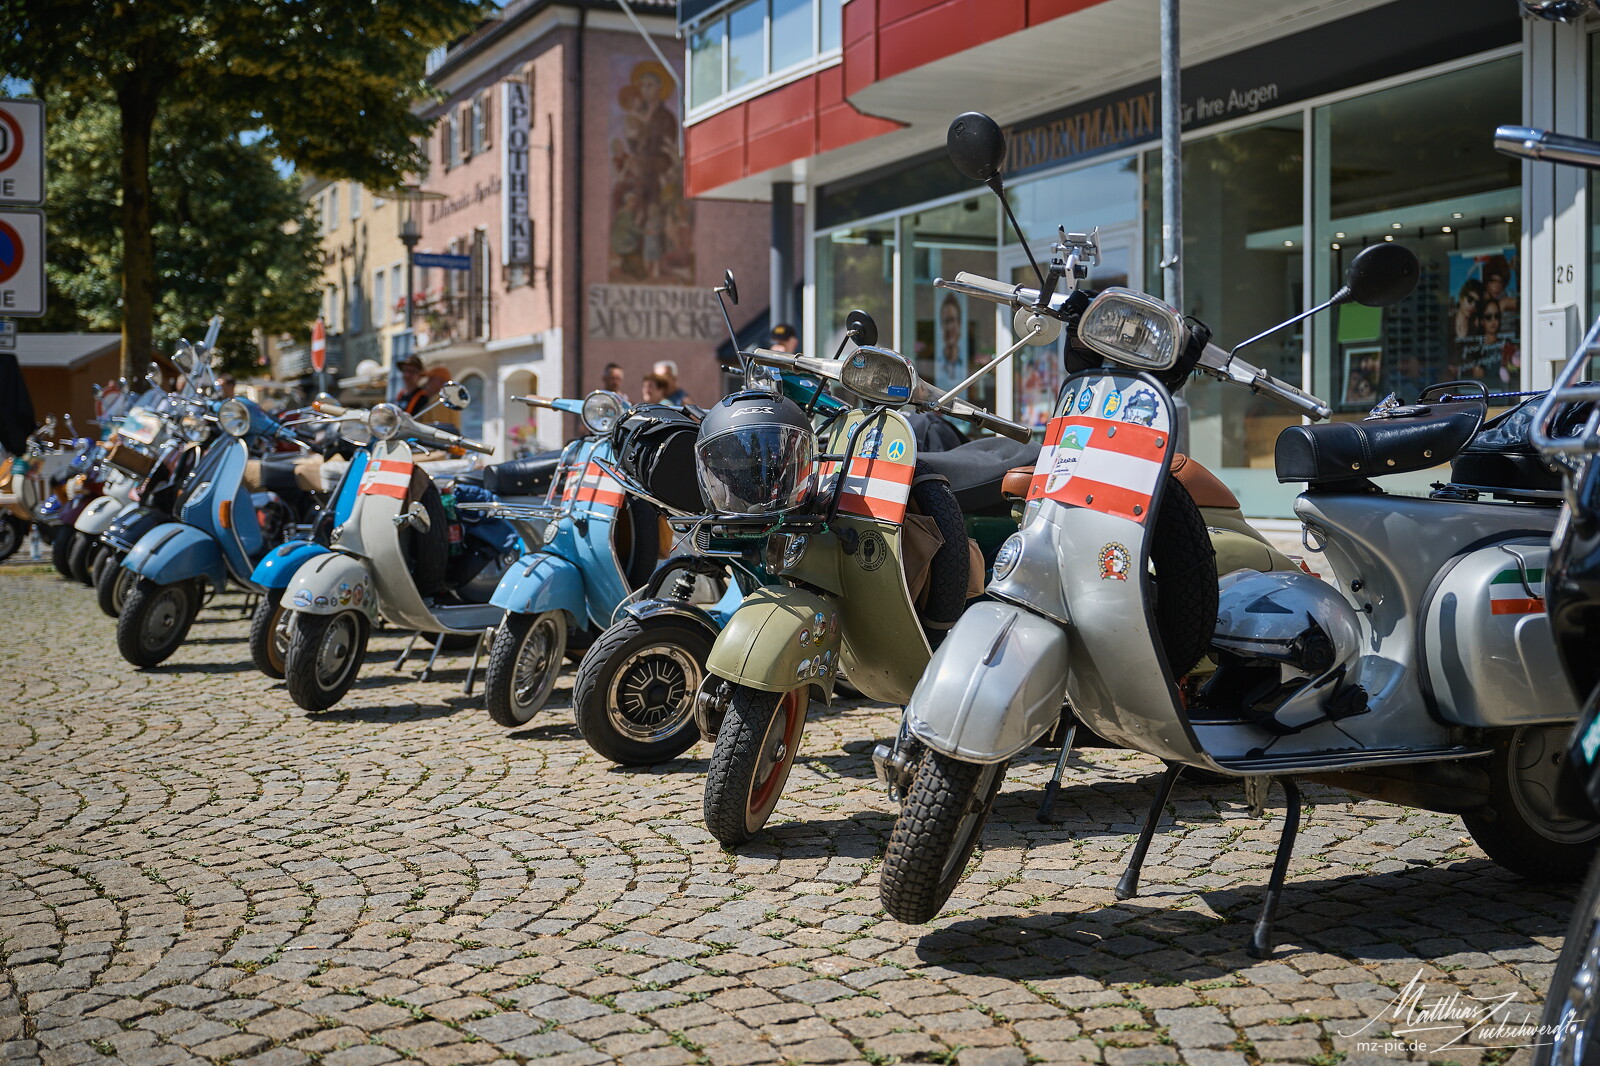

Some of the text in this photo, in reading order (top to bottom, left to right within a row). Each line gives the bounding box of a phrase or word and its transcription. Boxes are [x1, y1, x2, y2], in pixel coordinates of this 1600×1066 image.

[1180, 82, 1279, 125] ür Ihre Augen
[508, 84, 529, 261] APOTHEKE
[0, 178, 15, 197] E
[1557, 263, 1574, 284] 26
[0, 289, 16, 308] E
